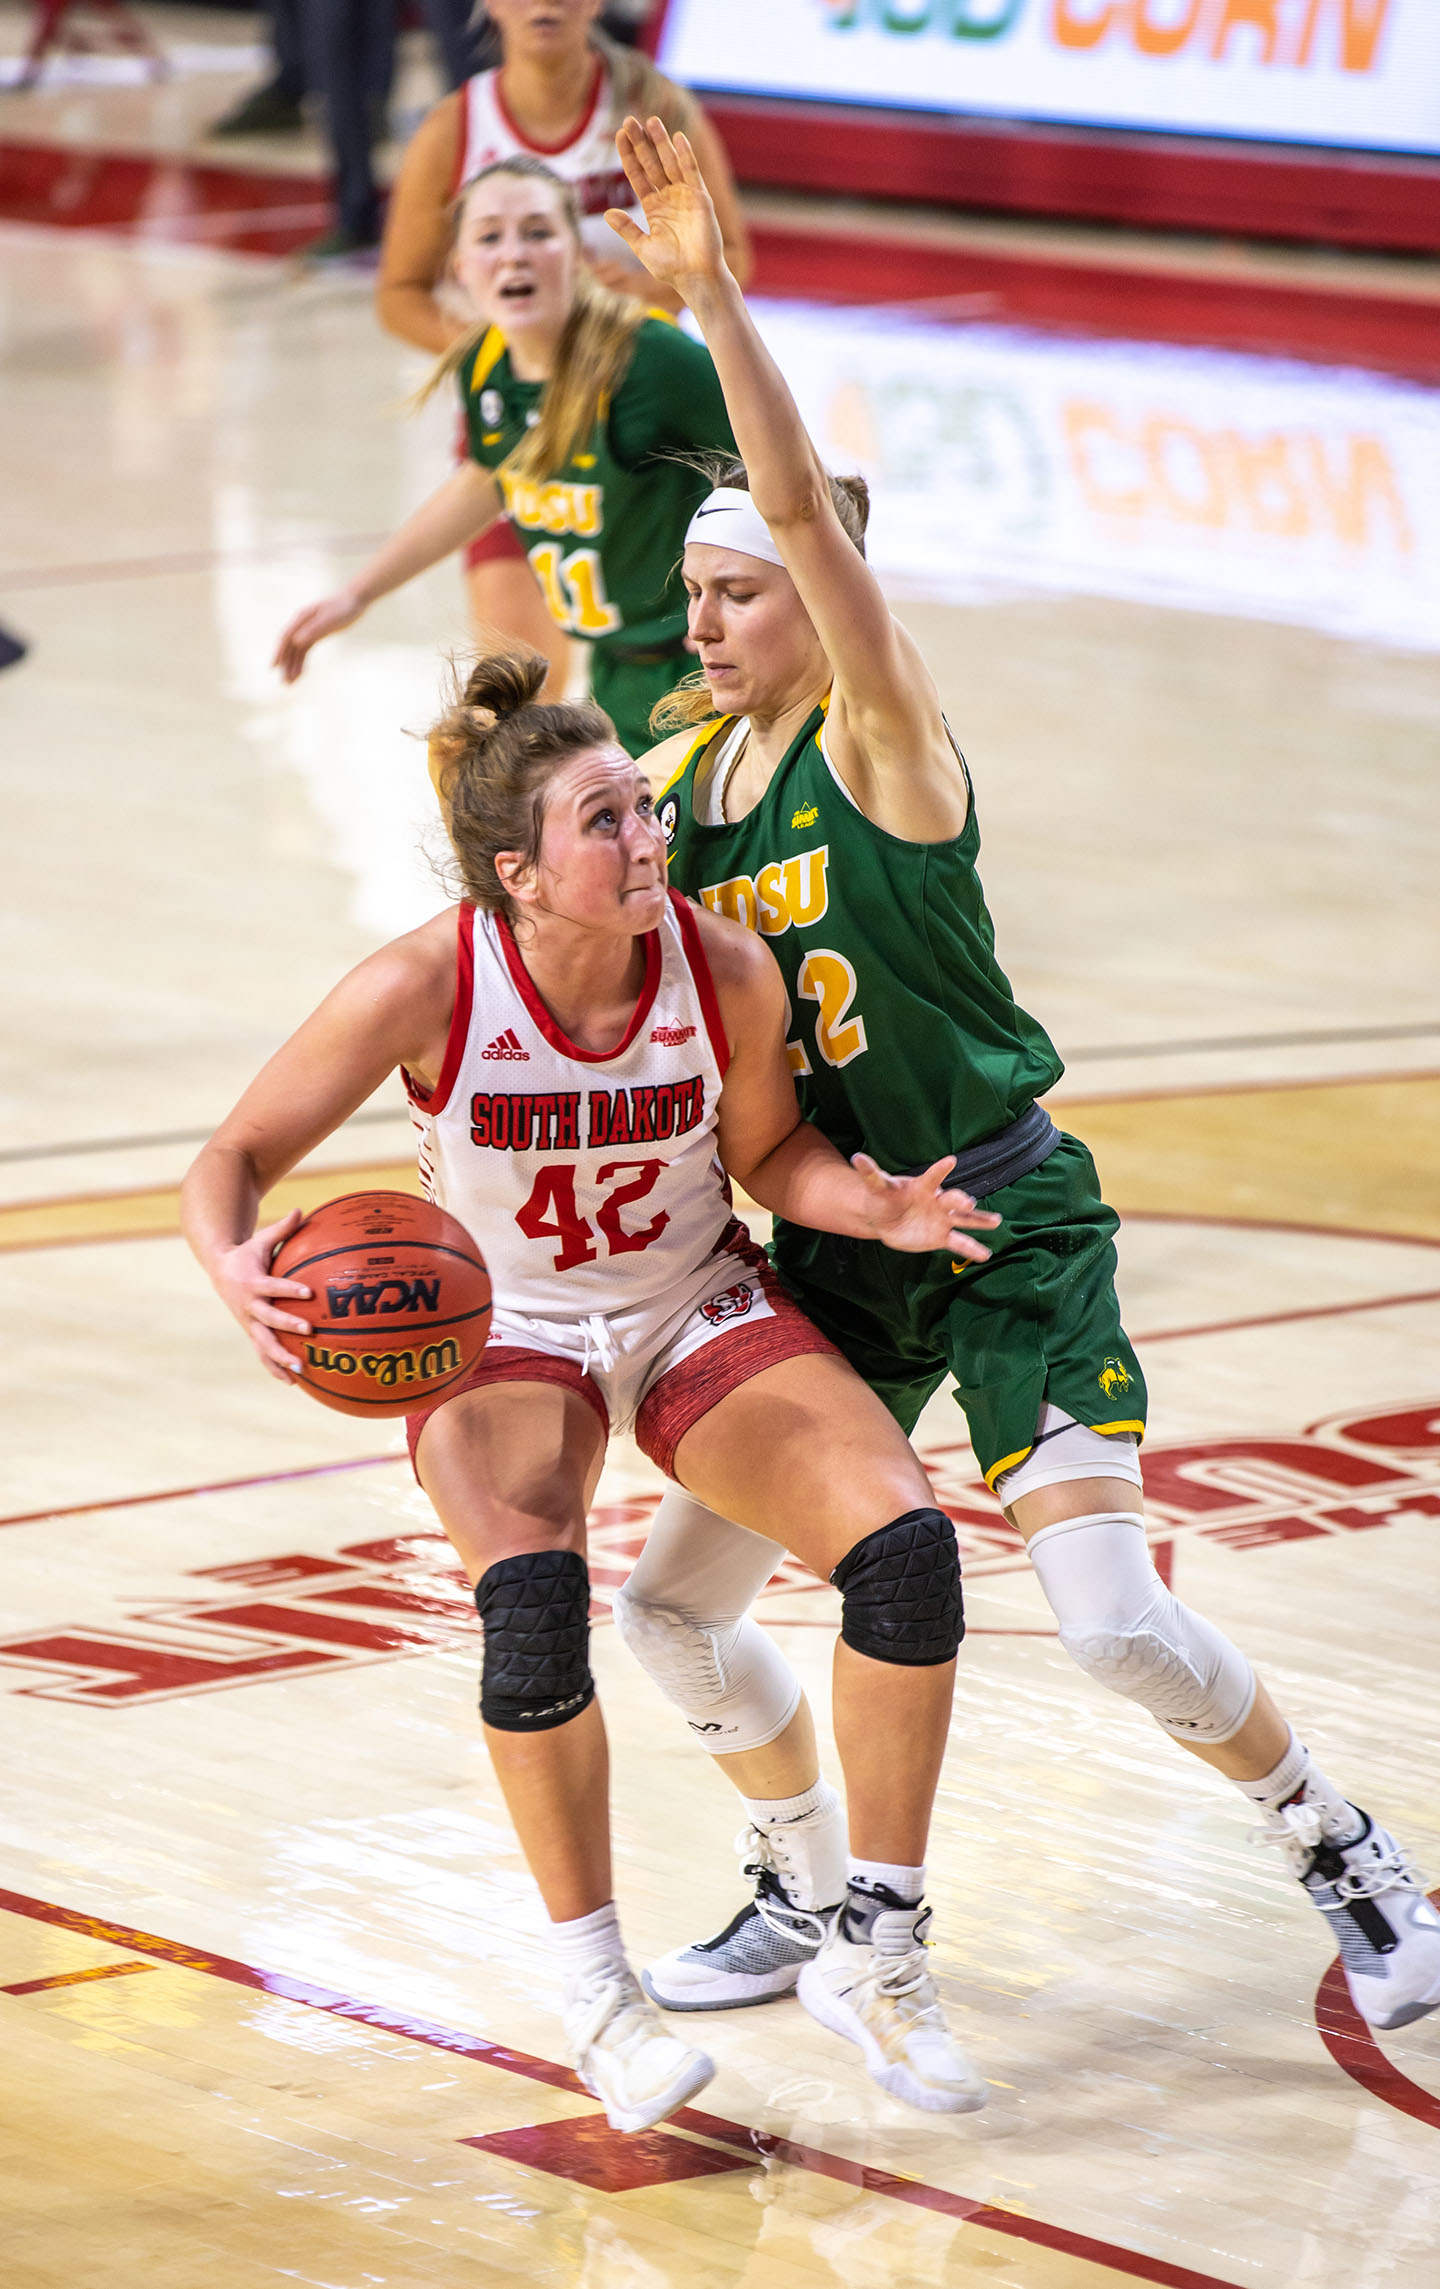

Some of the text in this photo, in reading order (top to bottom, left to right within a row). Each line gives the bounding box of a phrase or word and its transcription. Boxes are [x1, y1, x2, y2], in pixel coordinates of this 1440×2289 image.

[528, 541, 624, 636] 11
[784, 948, 869, 1076] 2
[481, 1048, 530, 1061] adidas
[470, 1074, 705, 1151] SOUTH DAKOTA
[514, 1158, 671, 1272] 42
[327, 1279, 441, 1319] NCAA
[303, 1337, 463, 1388] Wilson
